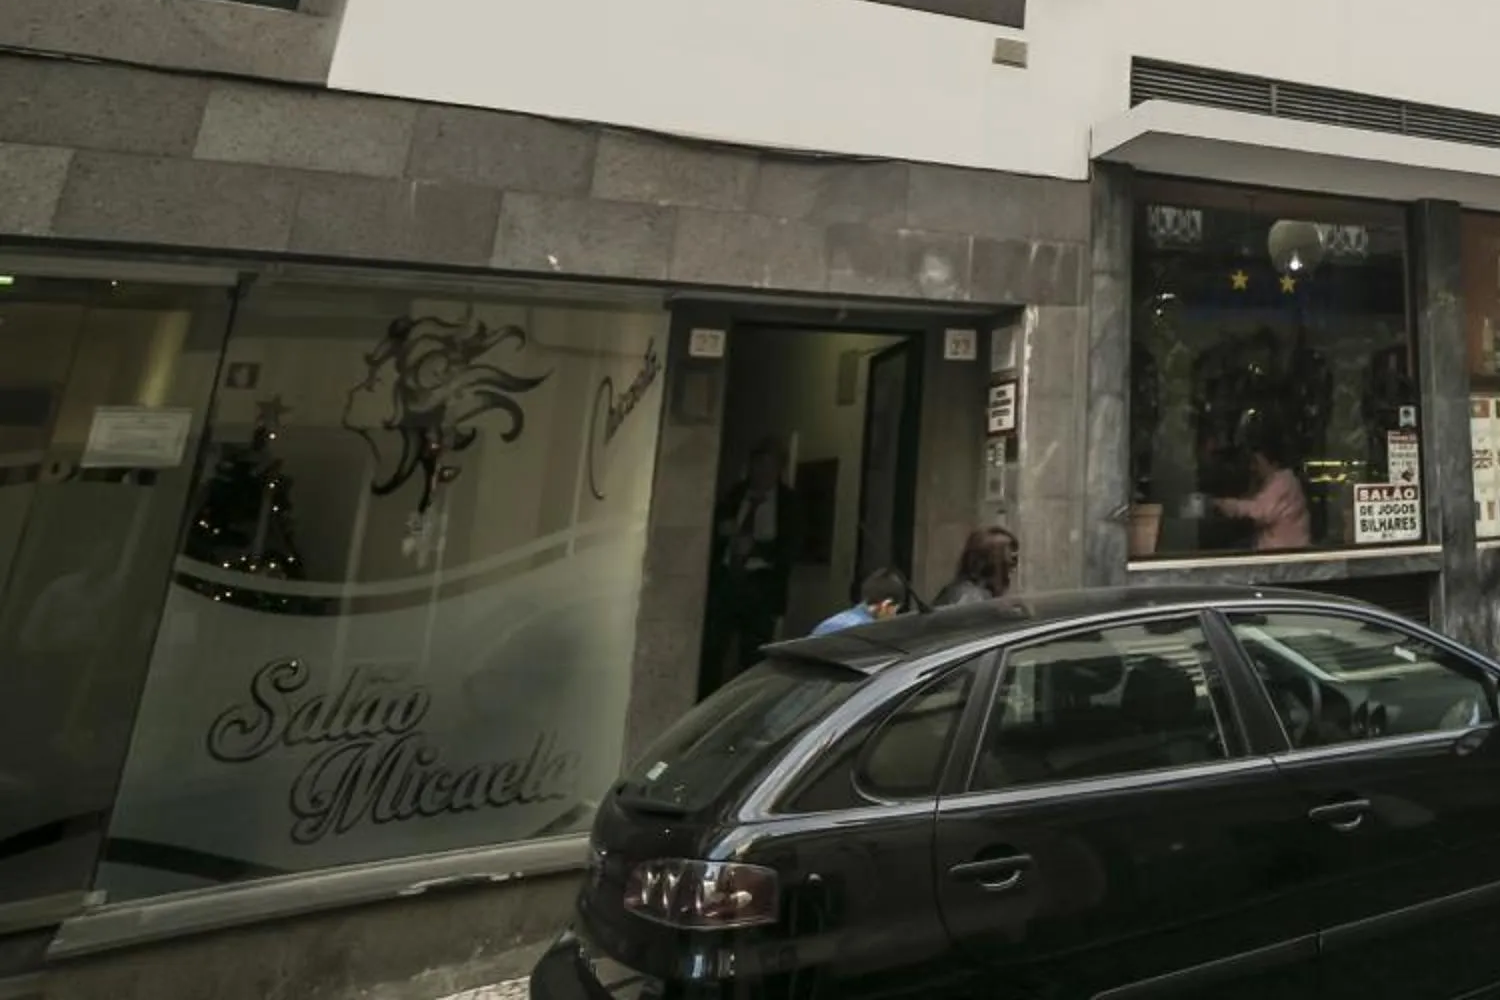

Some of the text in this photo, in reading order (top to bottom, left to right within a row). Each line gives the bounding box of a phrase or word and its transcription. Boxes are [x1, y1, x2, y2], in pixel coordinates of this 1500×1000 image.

[1359, 503, 1416, 516] DE JOGOS
[1359, 517, 1417, 533] BILHARES
[206, 656, 431, 764] Salão
[288, 730, 582, 846] Micaela
